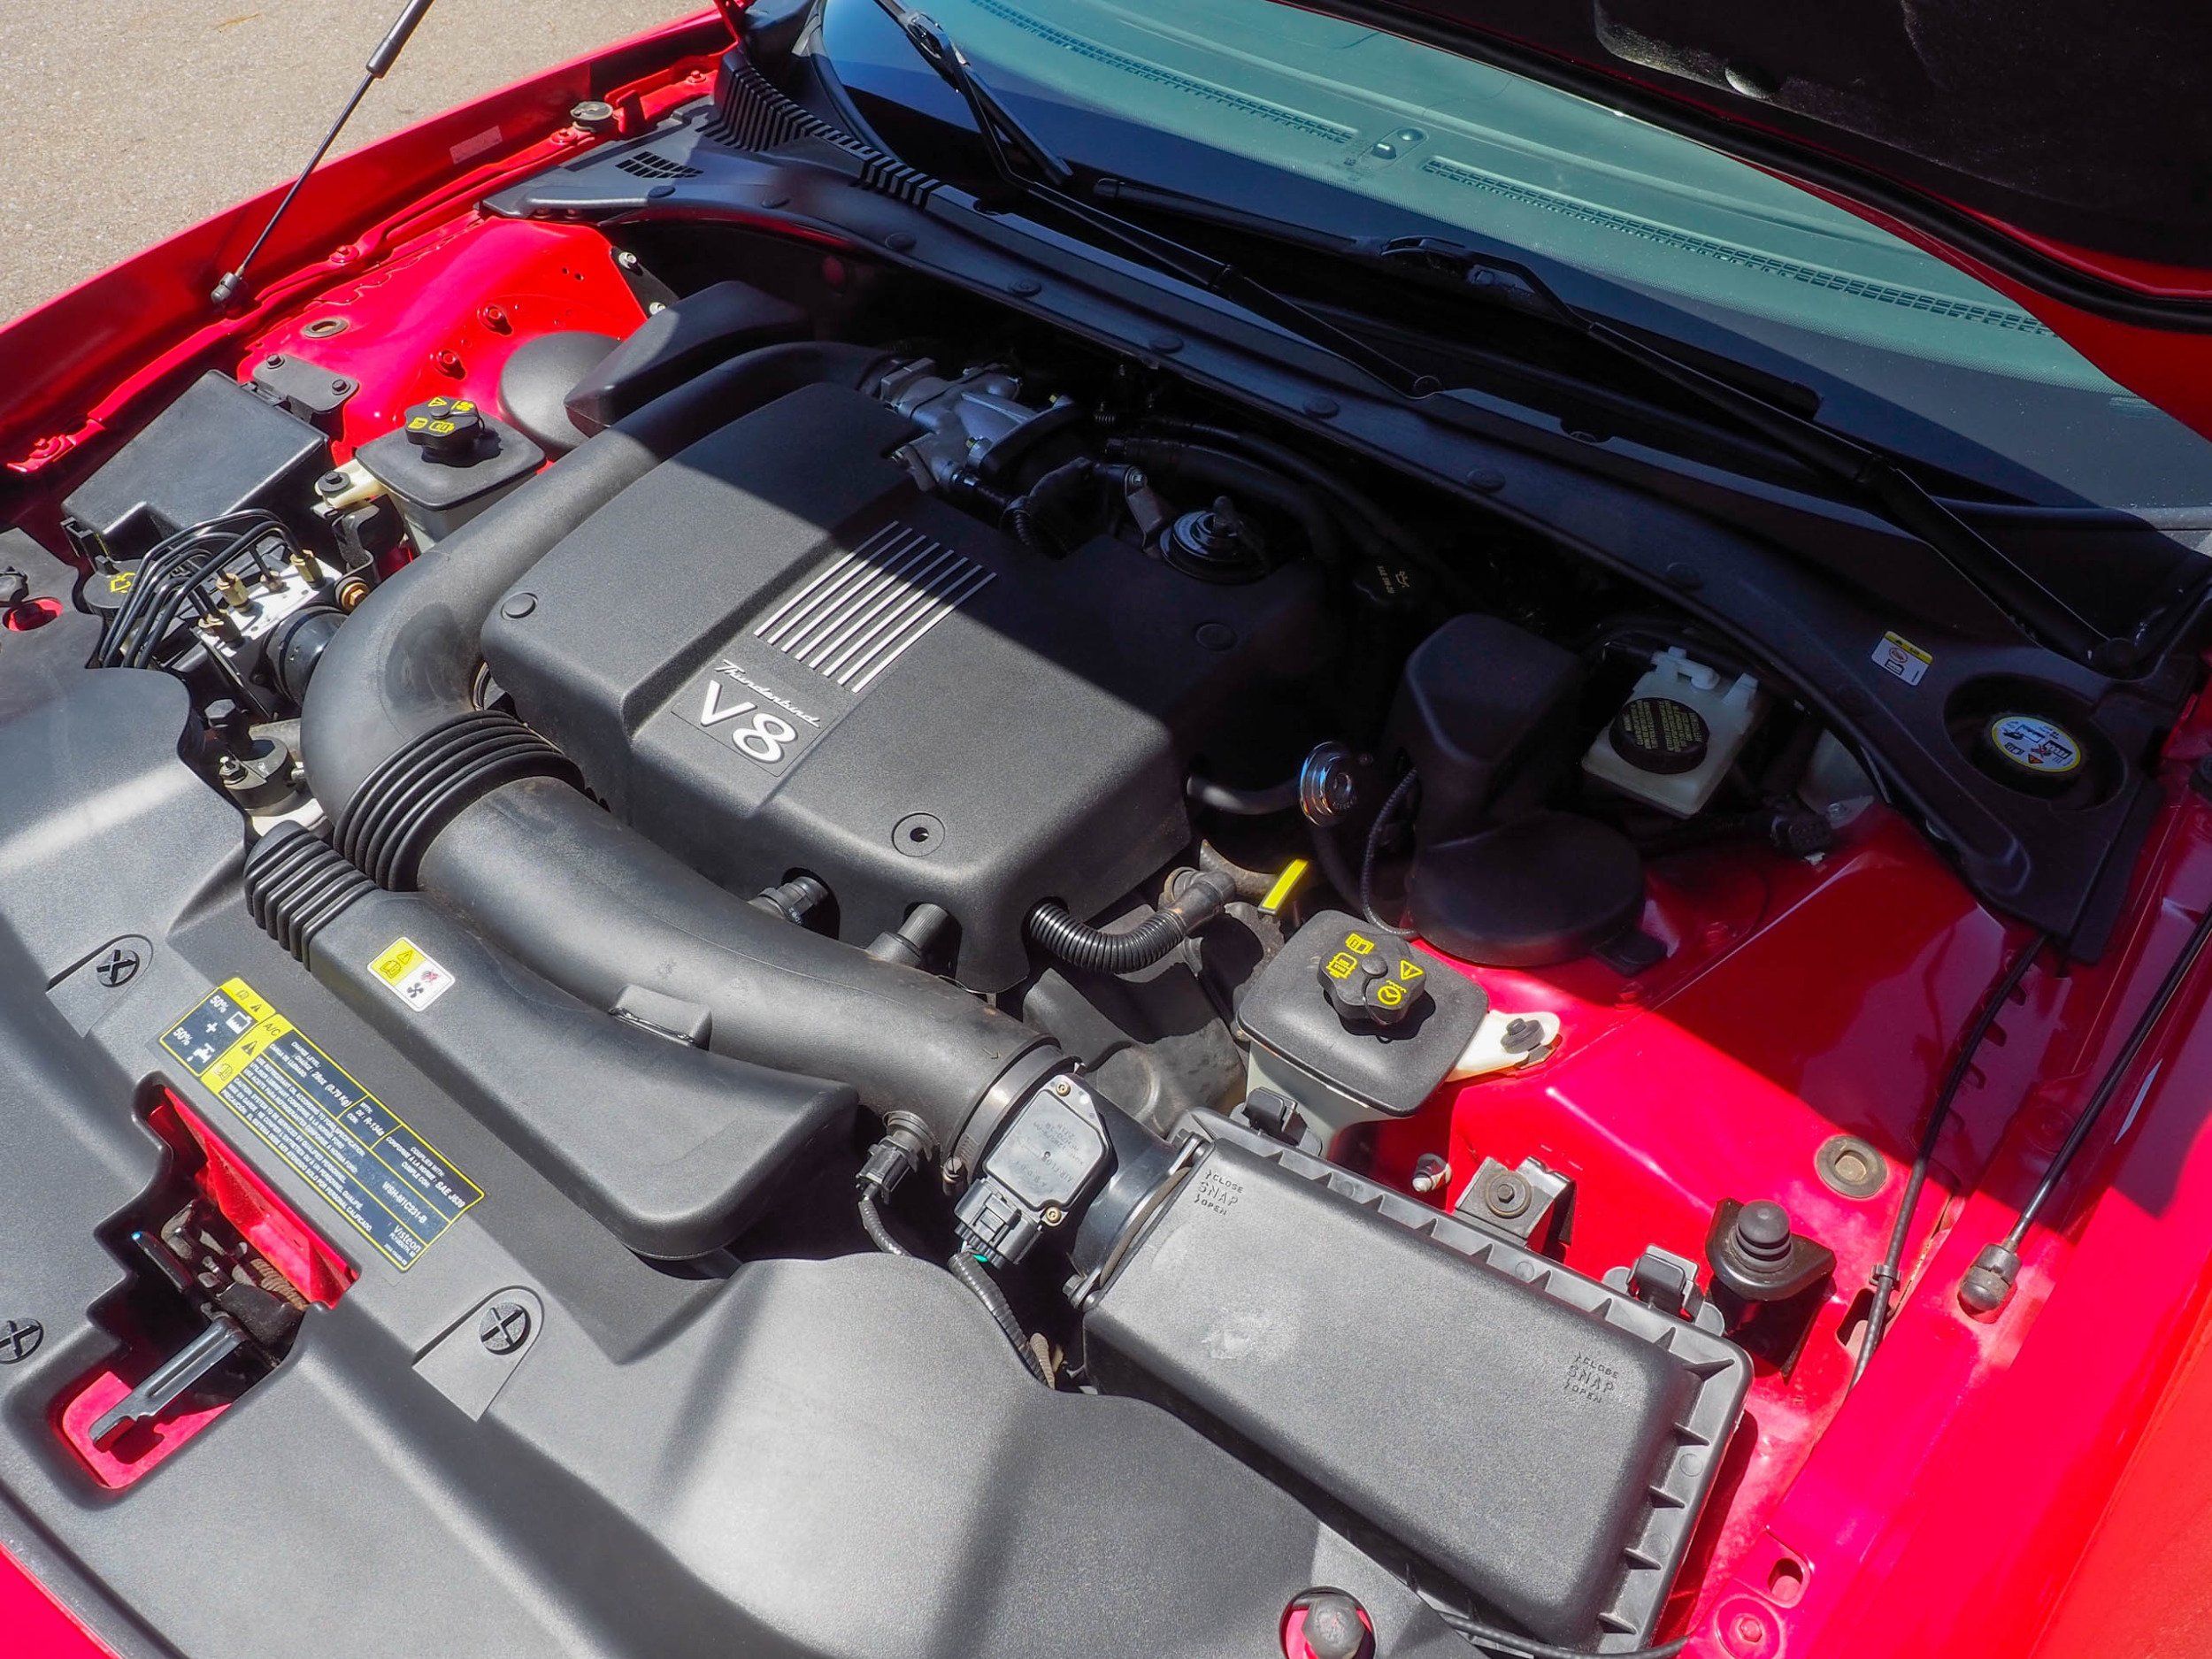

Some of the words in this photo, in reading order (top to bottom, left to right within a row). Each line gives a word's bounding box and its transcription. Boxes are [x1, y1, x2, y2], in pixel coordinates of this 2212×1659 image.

[713, 659, 821, 728] Thunderbird
[701, 680, 798, 764] V8
[210, 995, 229, 1013] 50%
[173, 1026, 193, 1045] 50%
[264, 1023, 281, 1036] A/C
[335, 1094, 353, 1109] Kg)
[362, 1116, 386, 1137] R-134a
[434, 1179, 452, 1196] SAE
[1198, 1181, 1239, 1206] SNAP
[1212, 1174, 1244, 1194] CLOSE
[1201, 1199, 1227, 1216] OPEN
[392, 1225, 422, 1253] Visteon
[1567, 1364, 1614, 1393] SNAP
[1572, 1385, 1601, 1403] OPEN
